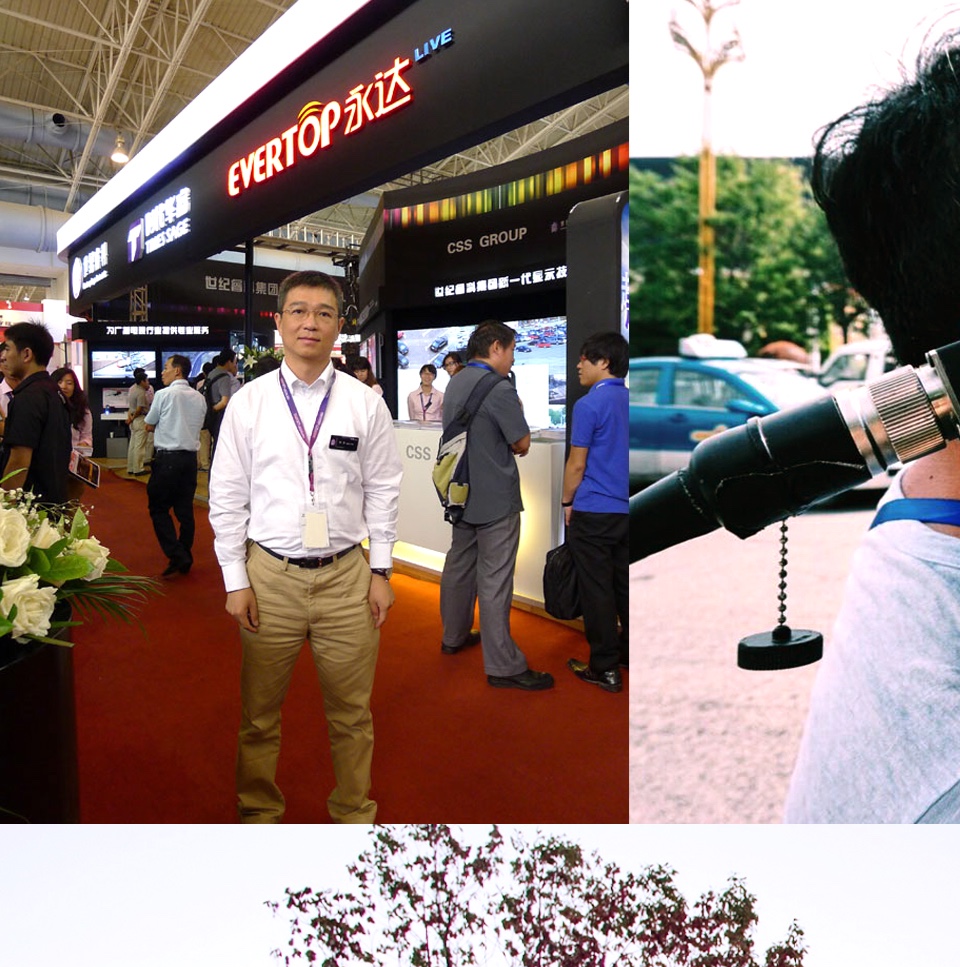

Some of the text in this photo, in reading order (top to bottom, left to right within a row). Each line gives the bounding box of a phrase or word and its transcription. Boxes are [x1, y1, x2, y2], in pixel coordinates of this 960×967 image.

[227, 28, 452, 197] EVERTOP 永达 LIVE
[447, 227, 528, 254] CSS GROUP
[205, 275, 279, 296] 世纪睿集团
[406, 444, 431, 461] CSS
